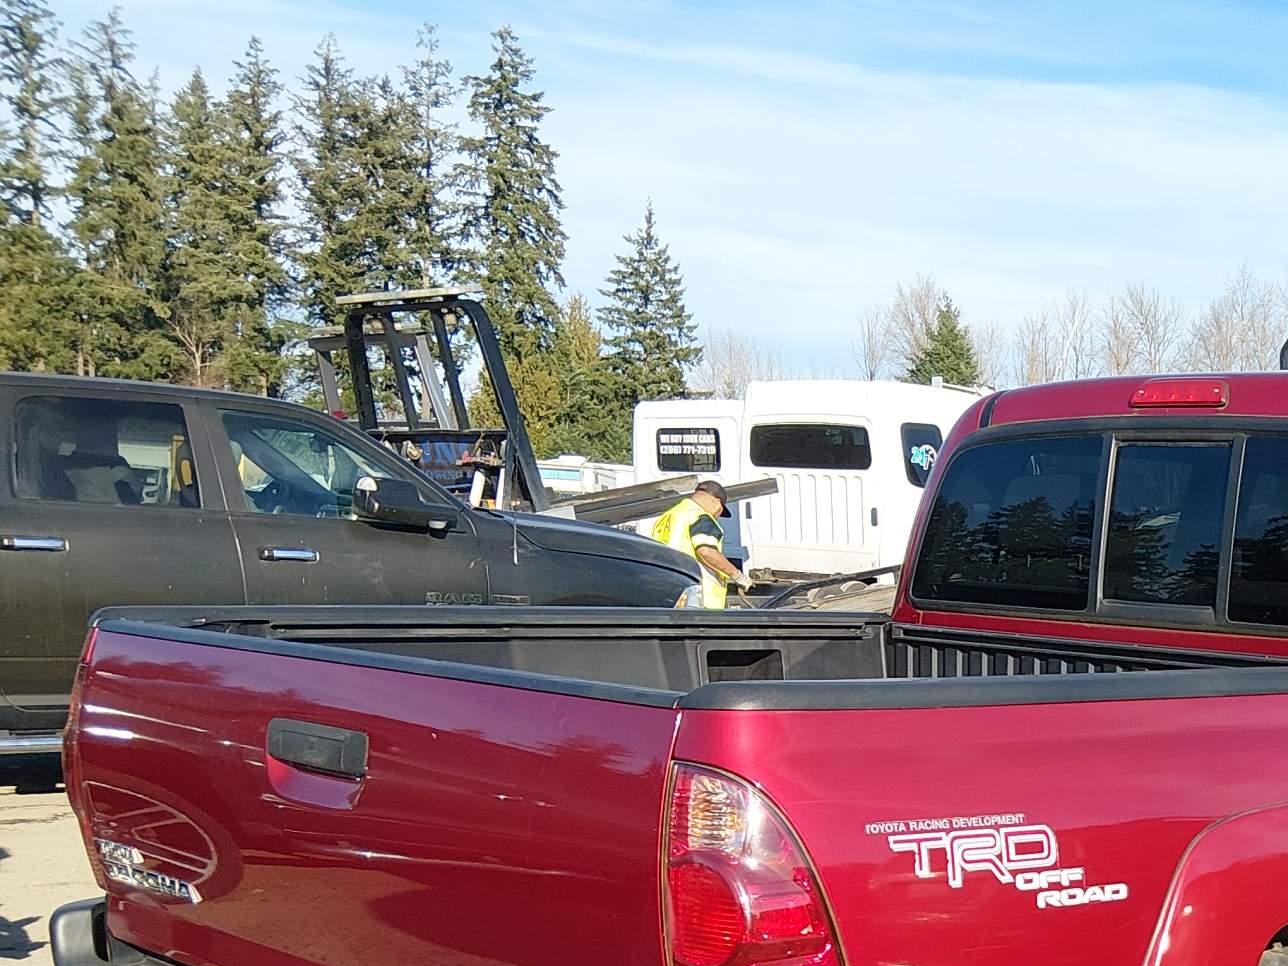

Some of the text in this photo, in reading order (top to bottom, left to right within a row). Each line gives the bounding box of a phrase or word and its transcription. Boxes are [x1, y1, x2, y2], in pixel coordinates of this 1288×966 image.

[699, 434, 716, 443] CARS
[865, 813, 1025, 834] TOYOTA RACING DEVELOPMENT
[887, 824, 1058, 888] TRD
[1015, 867, 1084, 890] OFF
[1036, 883, 1129, 909] ROAD
